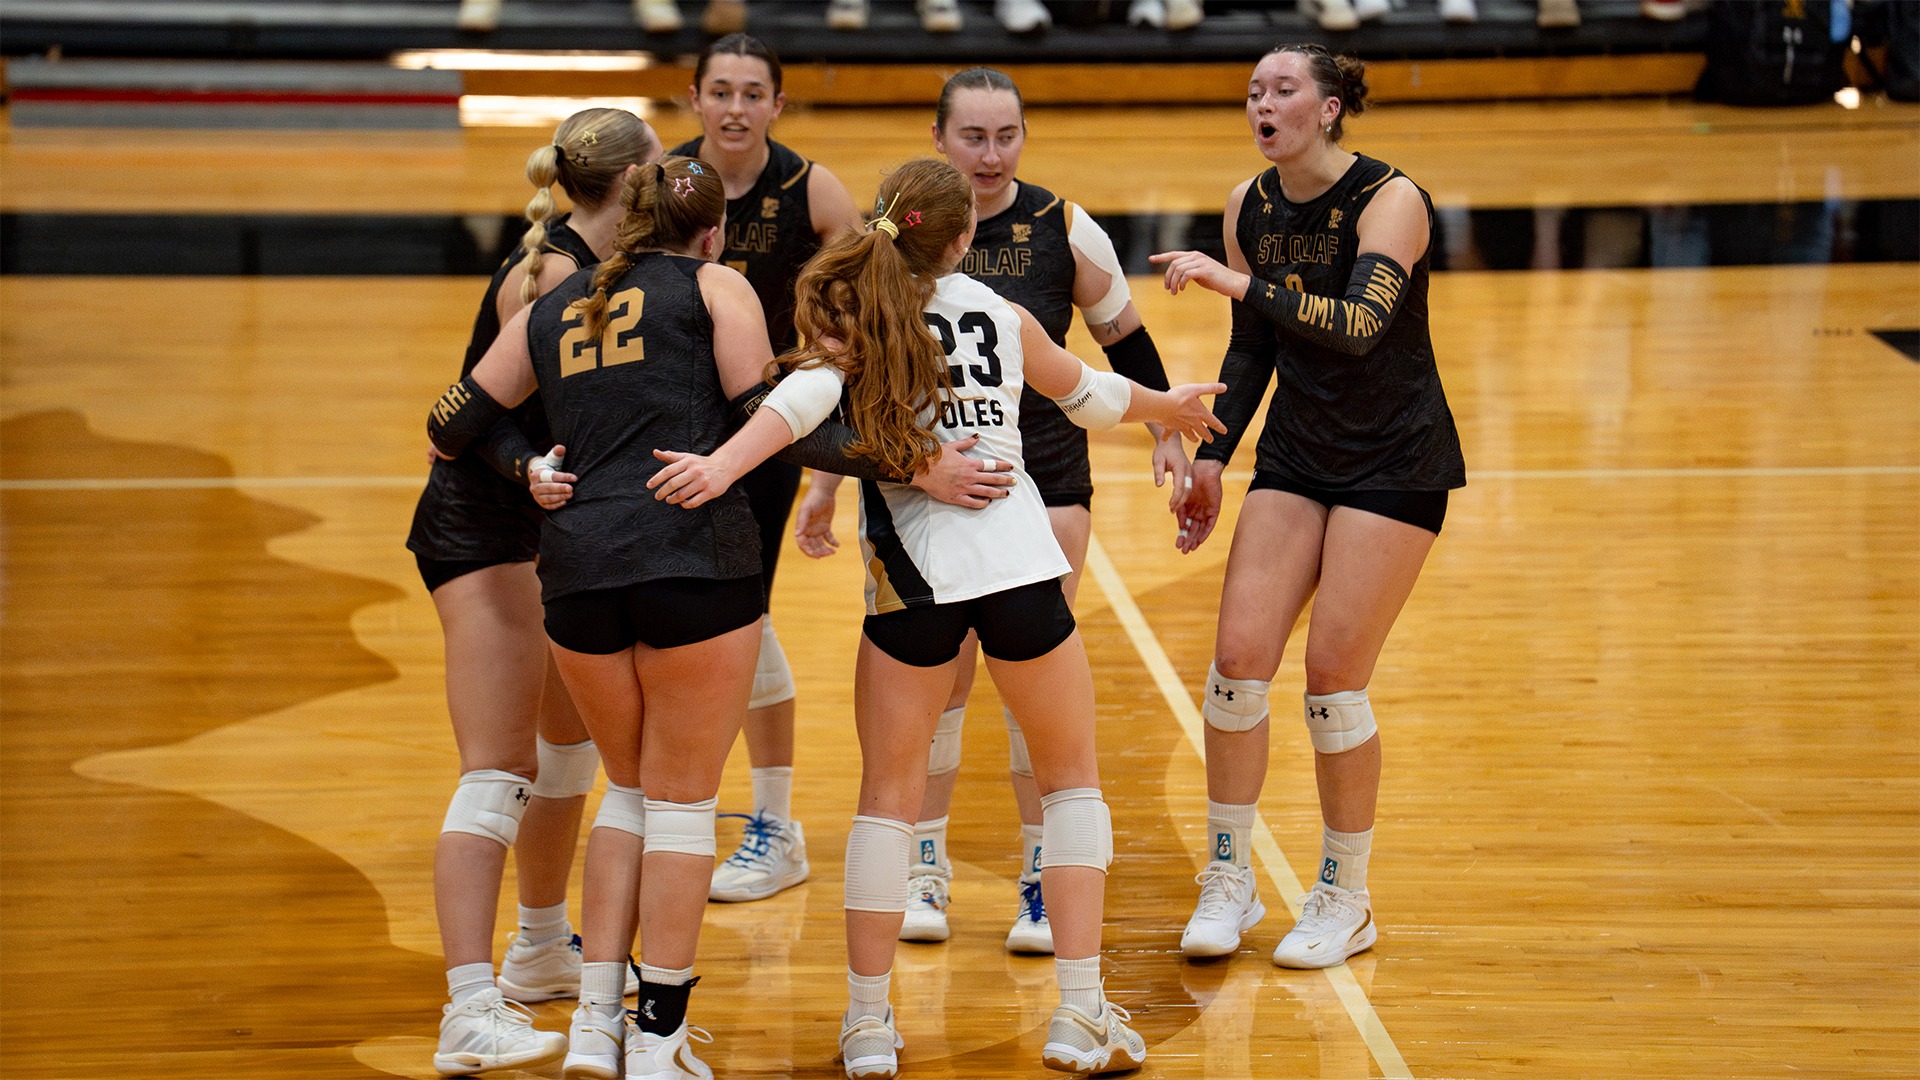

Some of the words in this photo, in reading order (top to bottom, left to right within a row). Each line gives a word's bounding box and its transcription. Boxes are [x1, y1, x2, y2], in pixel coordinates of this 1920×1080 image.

[727, 222, 778, 253] LAF
[1257, 233, 1286, 265] ST.
[1289, 233, 1339, 265] OLAF
[959, 247, 1032, 276] OLAF
[1362, 261, 1403, 315] YAH!
[1297, 292, 1334, 331] UM!
[1342, 299, 1383, 337] YAH!
[559, 286, 646, 379] 22
[940, 398, 1004, 429] OLES
